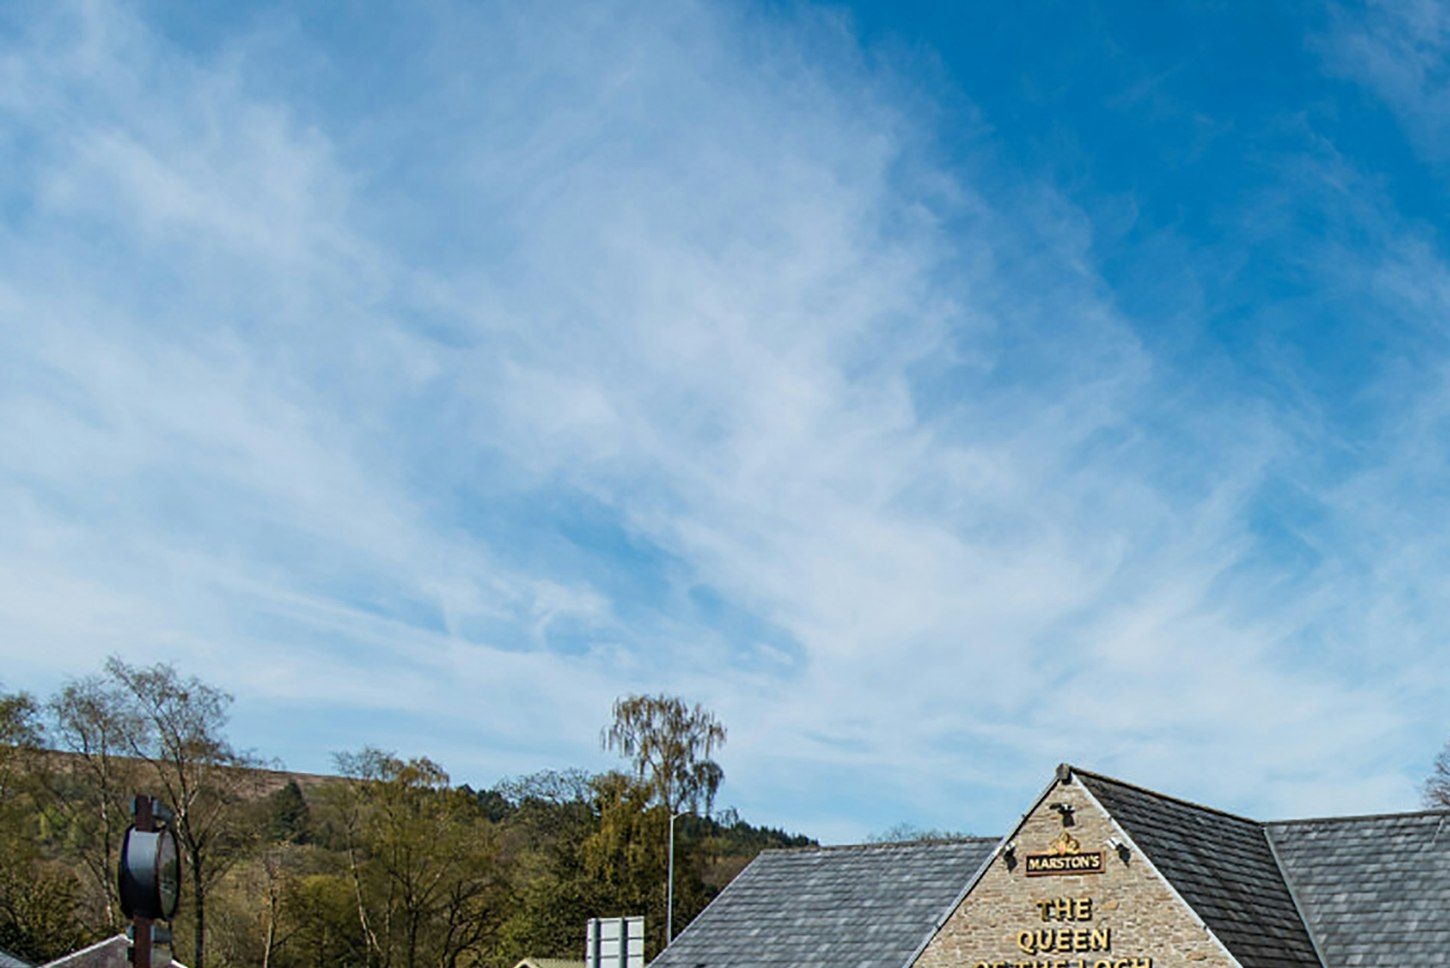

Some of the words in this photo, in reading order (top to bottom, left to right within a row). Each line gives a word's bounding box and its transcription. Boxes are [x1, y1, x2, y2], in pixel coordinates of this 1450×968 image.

[1028, 855, 1100, 870] MARSTON'S
[1037, 898, 1093, 921] THE
[1016, 928, 1111, 955] QUEEN
